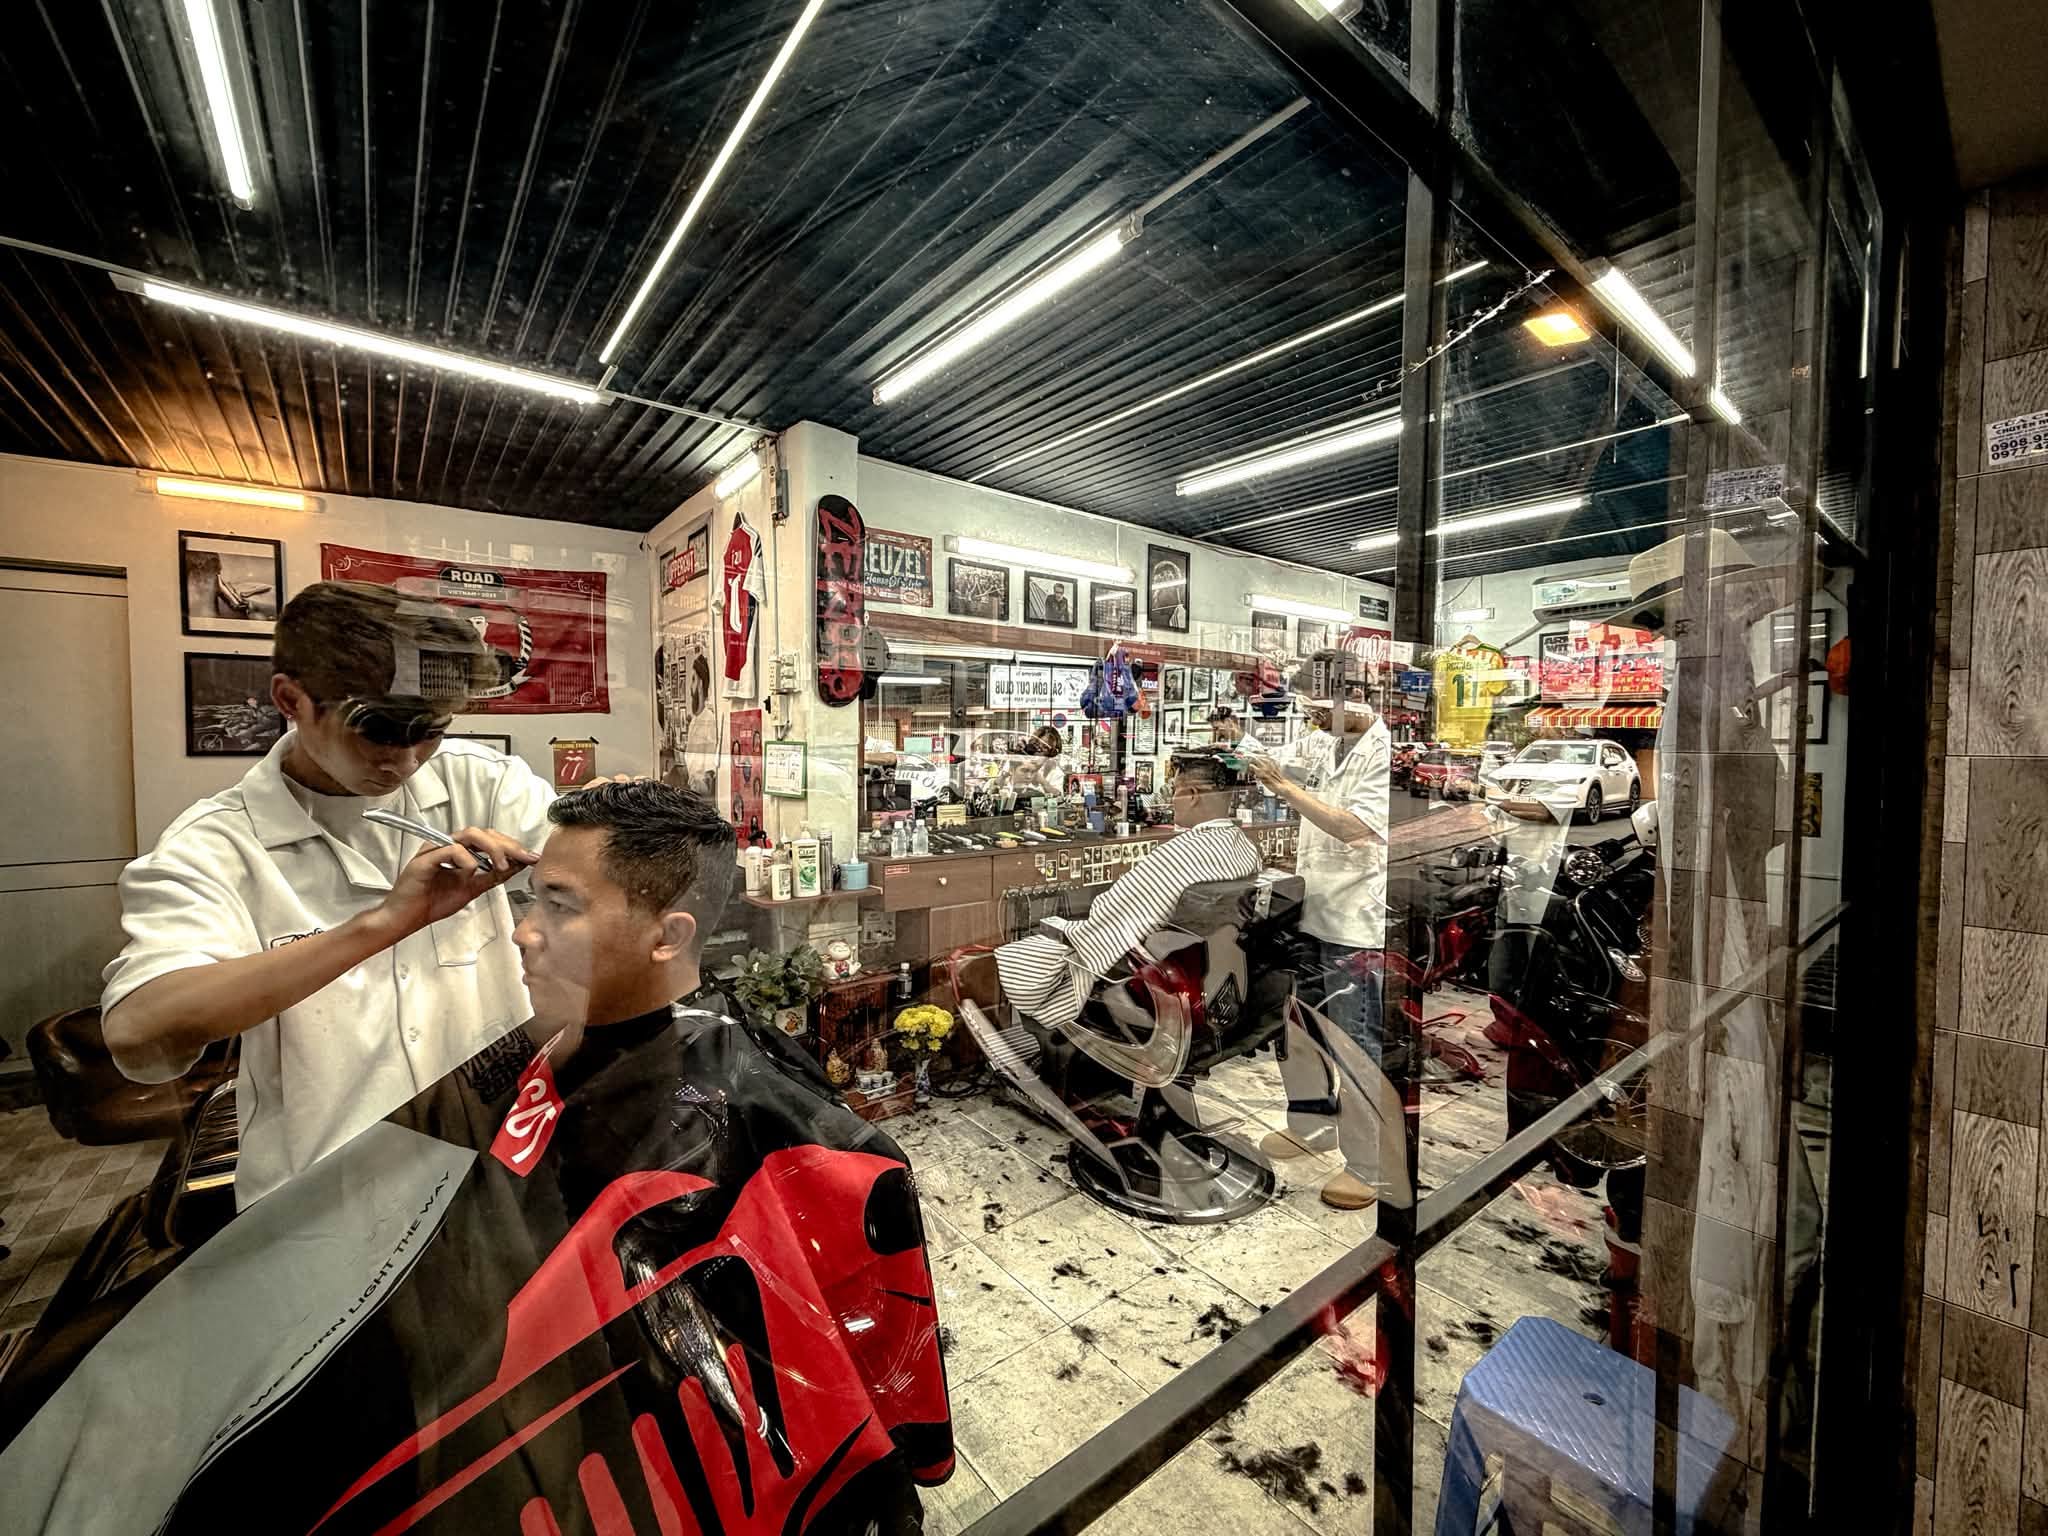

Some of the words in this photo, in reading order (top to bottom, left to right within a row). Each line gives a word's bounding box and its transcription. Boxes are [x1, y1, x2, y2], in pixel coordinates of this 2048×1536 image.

[451, 570, 495, 584] ROAD
[348, 1258, 395, 1315] LIGHT
[392, 1217, 422, 1256] THE
[419, 1170, 450, 1215] WAY
